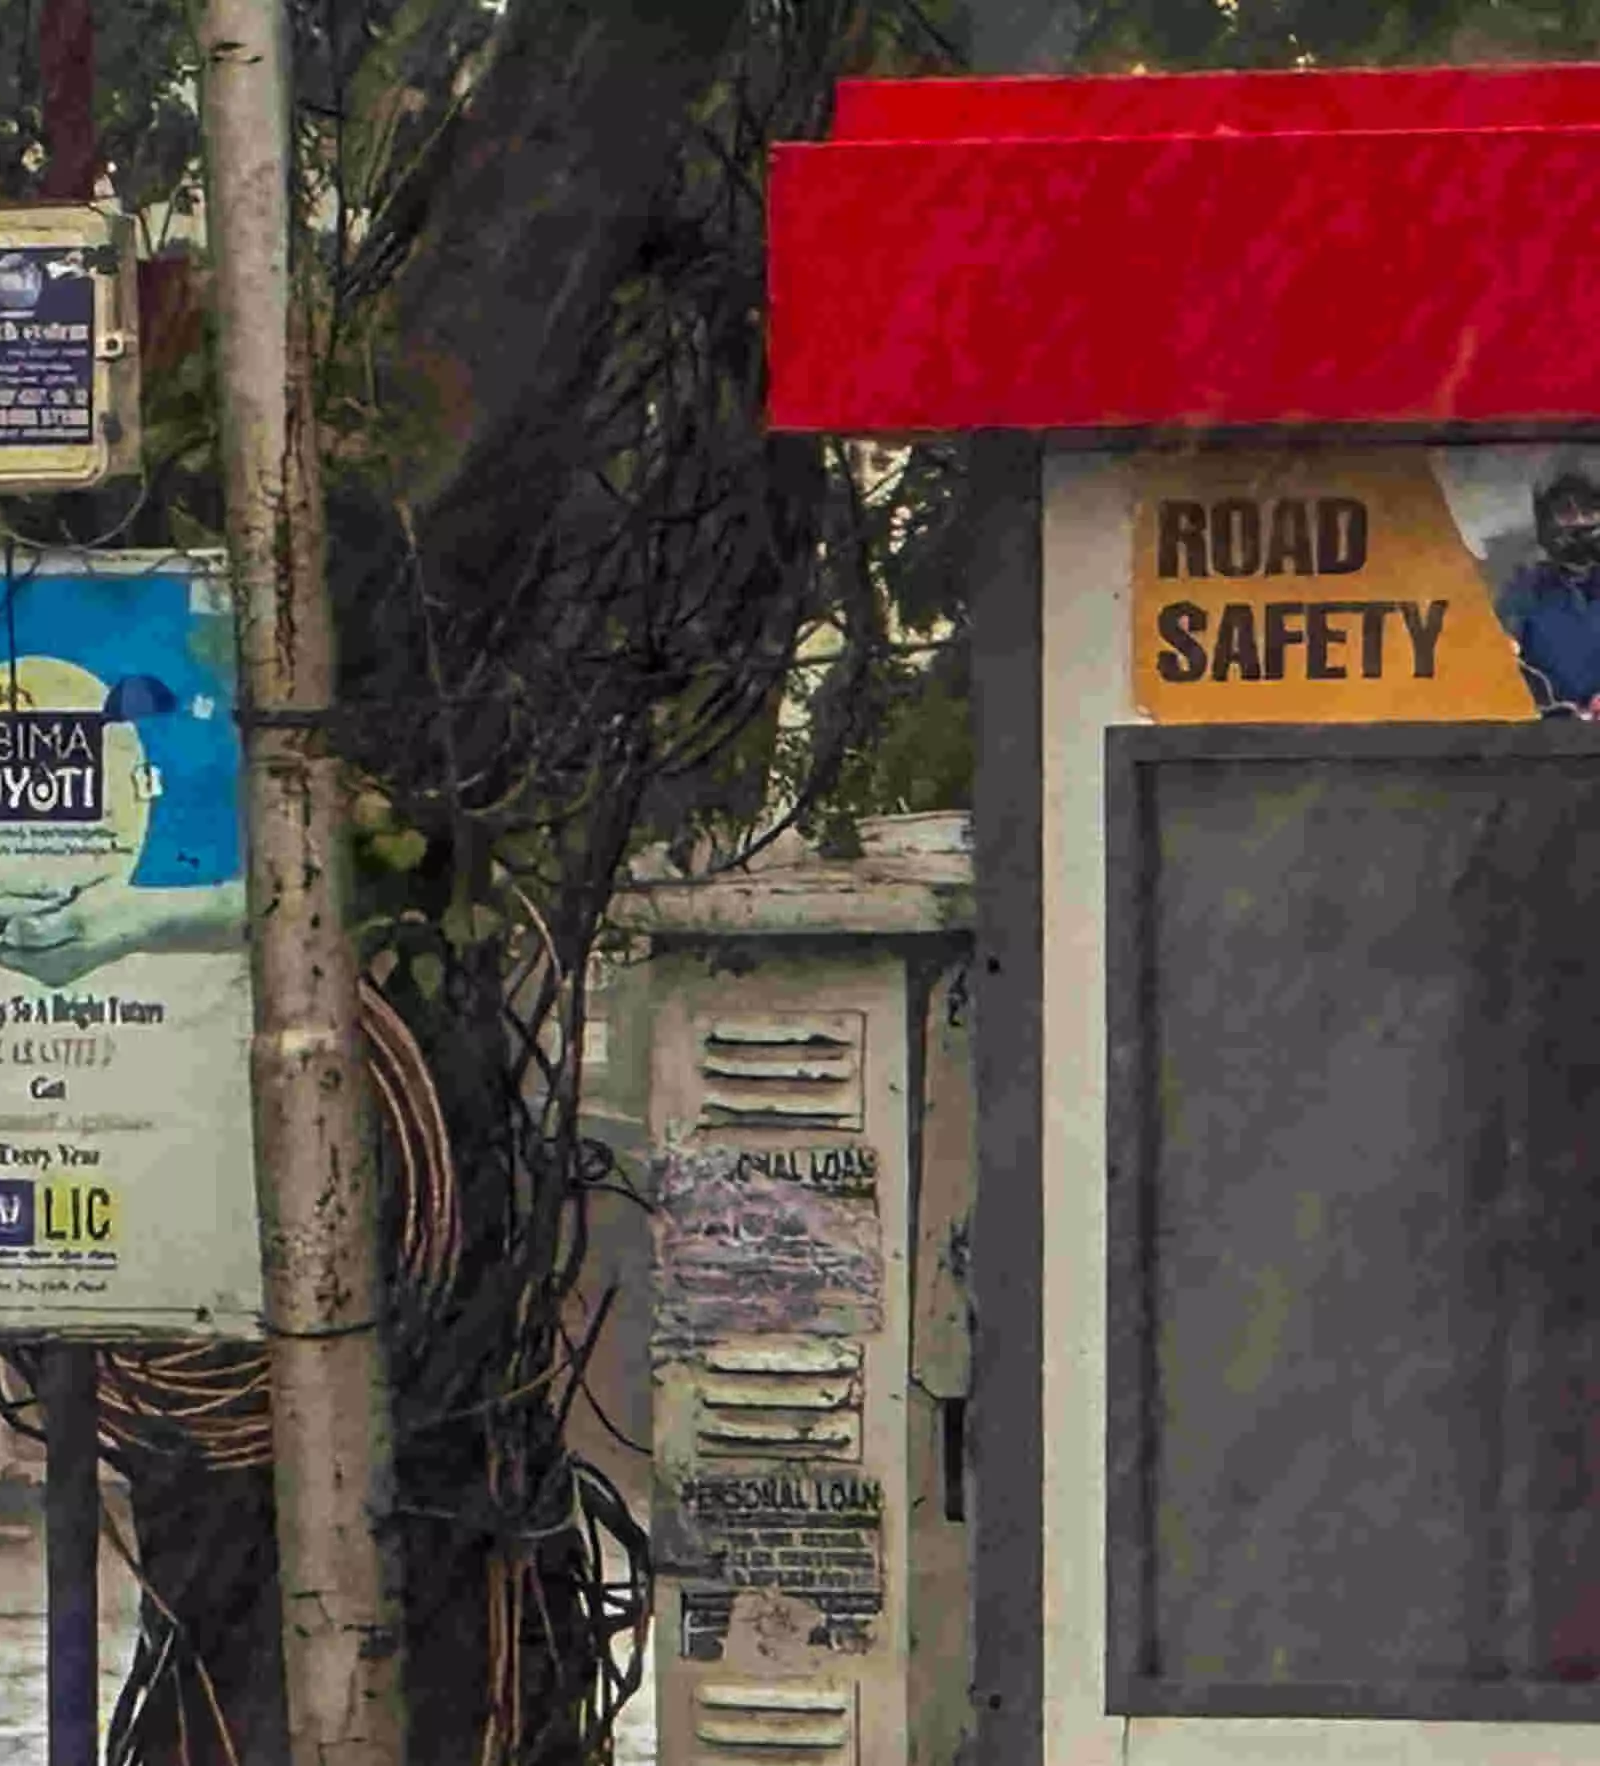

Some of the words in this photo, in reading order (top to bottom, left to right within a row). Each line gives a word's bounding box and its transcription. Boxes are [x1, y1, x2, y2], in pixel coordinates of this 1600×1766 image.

[1157, 497, 1368, 579] ROAD
[1156, 600, 1448, 683] SAFETY
[44, 1187, 111, 1241] LIC
